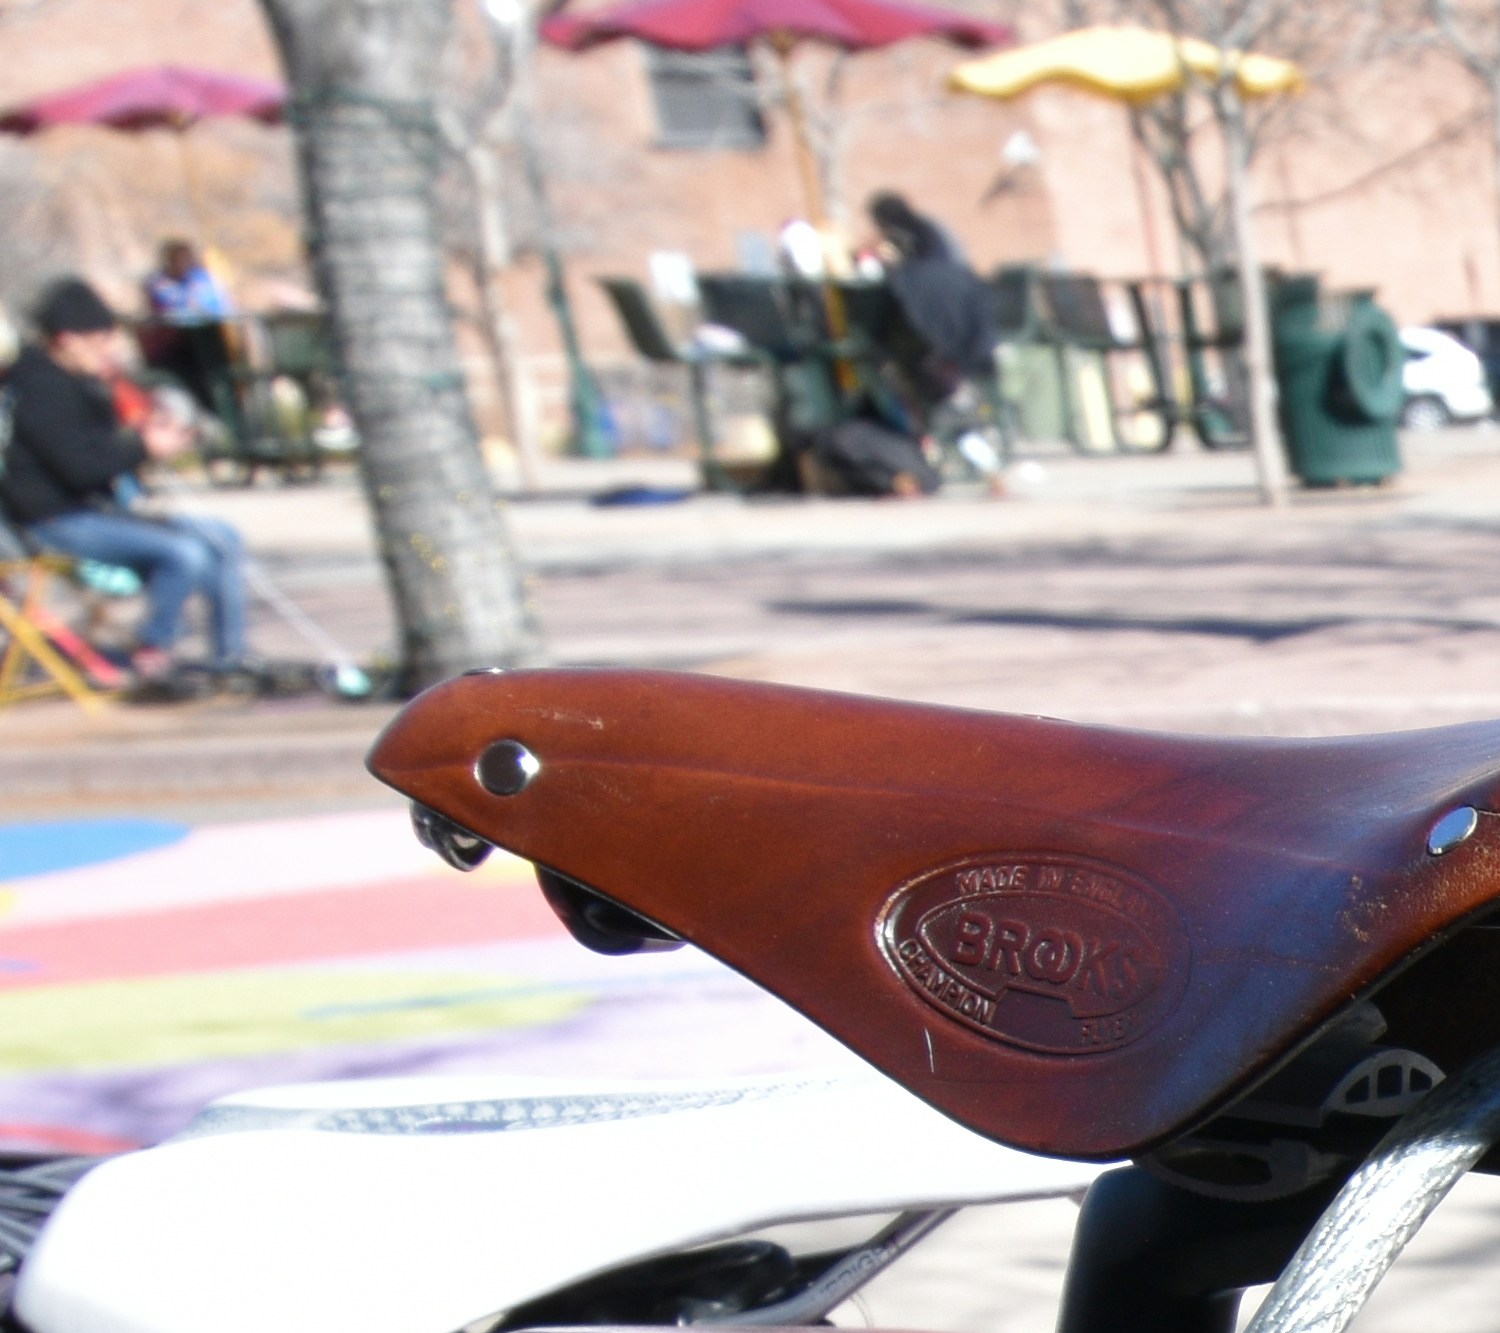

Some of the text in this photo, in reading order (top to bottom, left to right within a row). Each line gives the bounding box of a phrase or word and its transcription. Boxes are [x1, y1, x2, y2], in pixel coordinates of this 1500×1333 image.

[956, 865, 1029, 895] MADE
[1038, 866, 1064, 889] IN
[899, 939, 997, 1026] CHAMPION
[949, 911, 1141, 999] BROOKS
